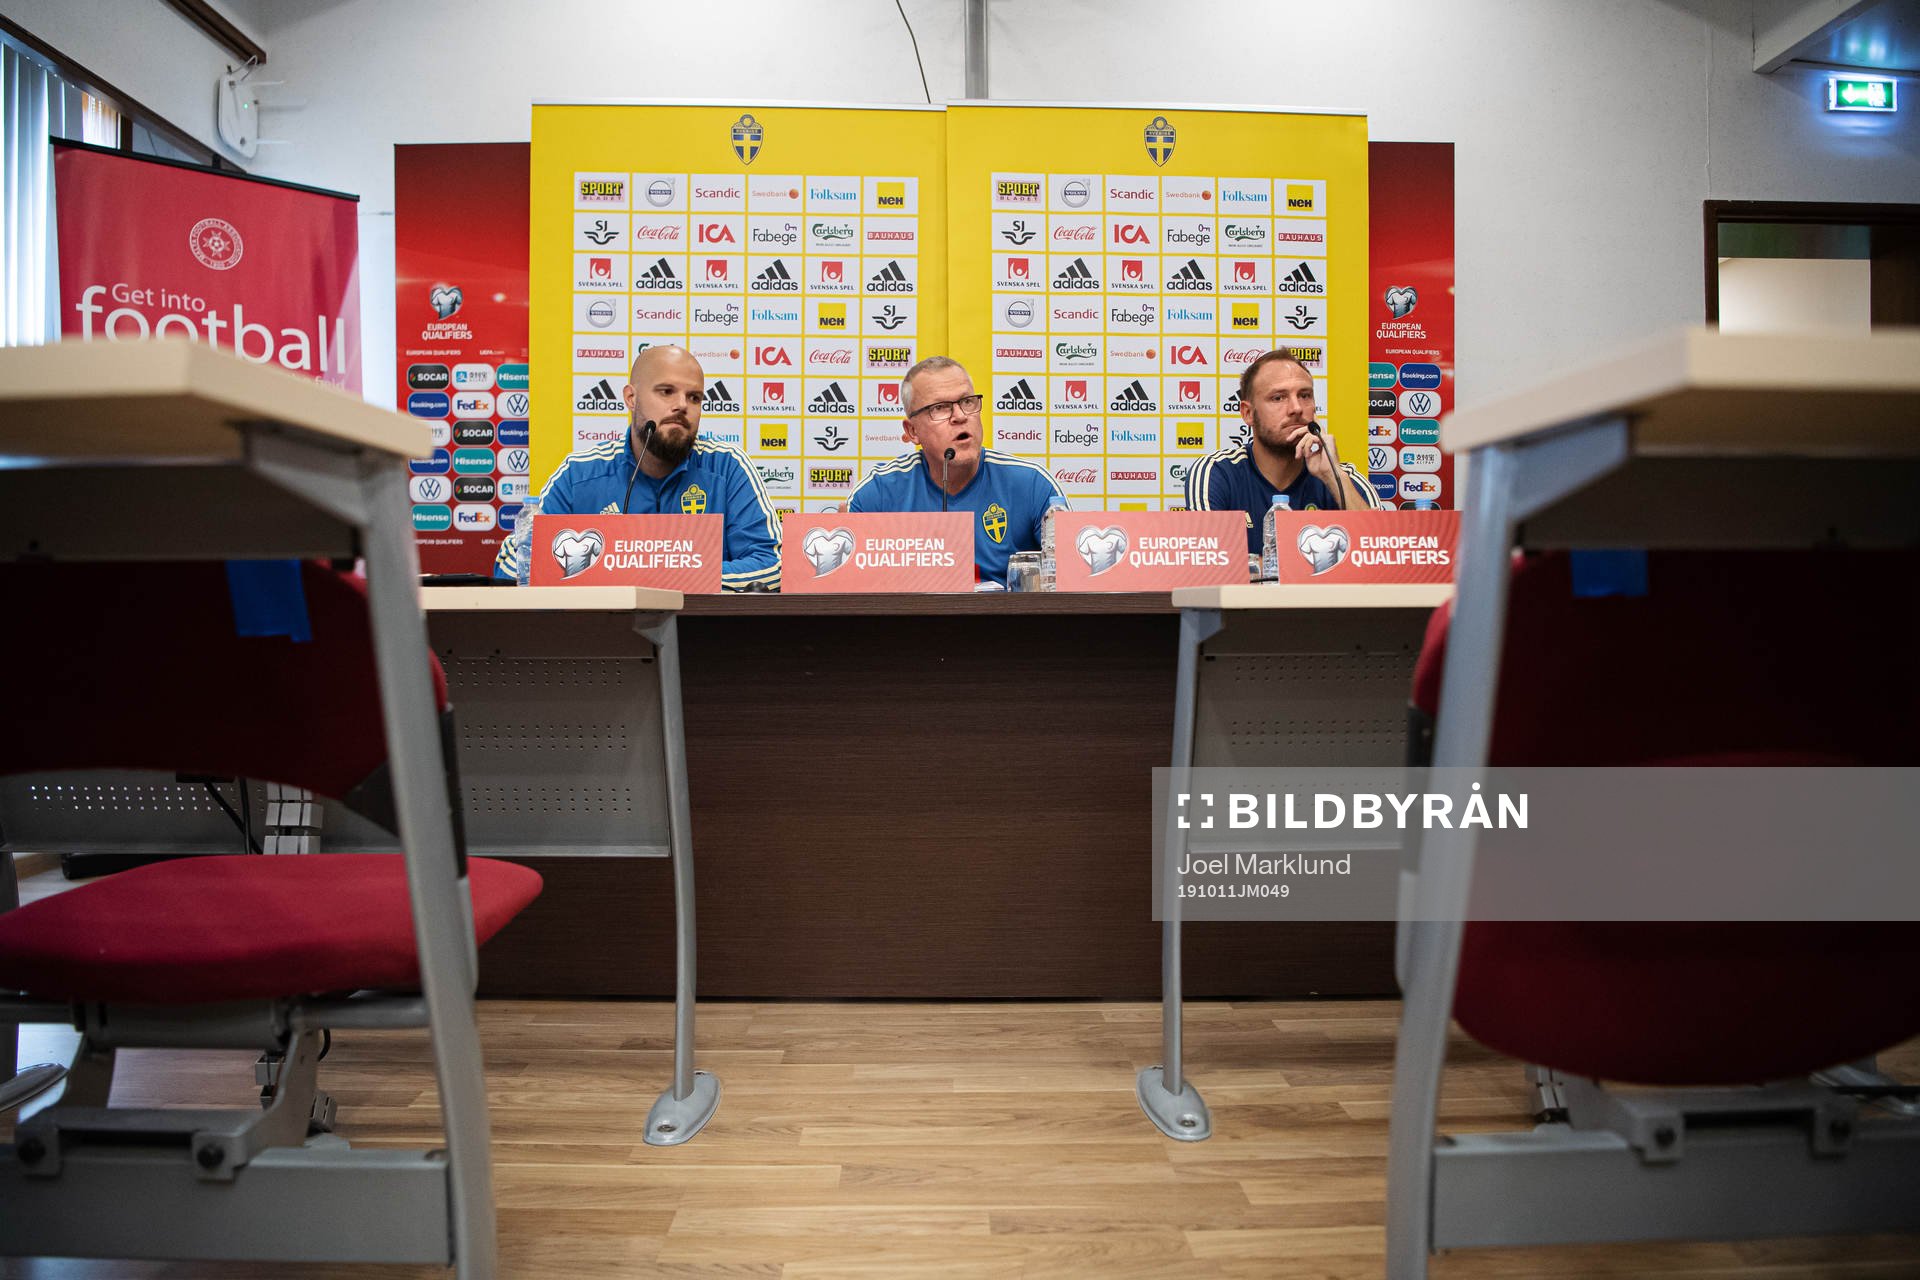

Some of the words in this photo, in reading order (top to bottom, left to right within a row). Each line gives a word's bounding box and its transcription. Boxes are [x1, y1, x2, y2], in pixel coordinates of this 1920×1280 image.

[581, 182, 623, 195] SPORT
[695, 188, 741, 199] Scandic
[810, 188, 856, 200] Folksam
[998, 182, 1039, 196] SPORT
[1110, 188, 1154, 200] Scandic
[1166, 191, 1200, 199] Swedbank
[1222, 190, 1268, 202] Folksam
[595, 220, 608, 232] SJ
[812, 223, 853, 239] Carlsberg
[1013, 220, 1025, 232] SJ
[1225, 224, 1265, 239] Carlsberg
[698, 223, 736, 243] ICA
[753, 228, 797, 245] Fabege
[868, 232, 913, 240] BAUHAUS
[1114, 224, 1150, 244] ICA
[1167, 229, 1211, 246] Fabege
[1279, 234, 1323, 242] BAUHAUS
[636, 278, 683, 289] adidas
[751, 278, 798, 290] adidas
[866, 280, 913, 292] adidas
[1053, 278, 1099, 289] adidas
[1166, 279, 1213, 291] adidas
[1279, 281, 1323, 293] adidas
[112, 283, 154, 305] Get
[160, 285, 206, 312] into
[636, 309, 682, 320] Scandic
[752, 309, 798, 321] Folksam
[884, 305, 896, 317] SJ
[1054, 309, 1099, 319] Scandic
[1167, 309, 1213, 321] Folksam
[1295, 305, 1307, 317] SJ
[695, 309, 738, 326] Fabege
[1111, 309, 1154, 326] Fabege
[76, 286, 345, 373] football
[427, 323, 467, 331] EUROPEAN
[1381, 322, 1421, 330] EUROPEAN
[422, 331, 472, 340] QUALIFIERS
[1376, 330, 1427, 339] QUALIFIERS
[577, 350, 624, 358] BAUHAUS
[755, 346, 792, 366] ICA
[869, 348, 910, 362] SPORT
[997, 350, 1042, 358] BAUHAUS
[1056, 343, 1097, 357] Carlsberg
[1171, 346, 1208, 365] ICA
[1290, 348, 1321, 361] PORT
[417, 373, 448, 381] SOCAR
[1402, 372, 1438, 380] Booking.com
[457, 400, 488, 410] FedEx
[577, 399, 625, 411] adidas
[702, 400, 740, 412] didas
[808, 402, 855, 413] adidas
[996, 399, 1043, 411] adidas
[1111, 400, 1156, 412] adidas
[462, 429, 493, 437] SOCAR
[578, 431, 624, 440] Scandic
[825, 426, 838, 438] SJ
[997, 430, 1042, 440] Scandic
[1111, 430, 1157, 442] Folksam
[1240, 424, 1252, 436] SJ
[1368, 426, 1391, 436] edEx
[706, 431, 739, 442] lksam
[1055, 430, 1098, 447] Fabege
[455, 457, 493, 465] Hisense
[810, 470, 852, 483] SPORT
[1111, 472, 1156, 480] BAUHAUS
[463, 485, 494, 493] SOCAR
[1404, 482, 1435, 492] FedEx
[412, 513, 449, 521] Hisense
[459, 512, 490, 522] FedEx
[615, 539, 693, 553] EUROPEAN
[866, 538, 945, 552] EUROPEAN
[1139, 537, 1218, 550] EUROPEAN
[1360, 536, 1438, 549] EUROPEAN
[603, 553, 702, 572] QUALIFIERS
[855, 552, 955, 570] QUALIFIERS
[1129, 550, 1229, 568] QUALIFIERS
[1351, 549, 1449, 567] QUALIFIERS
